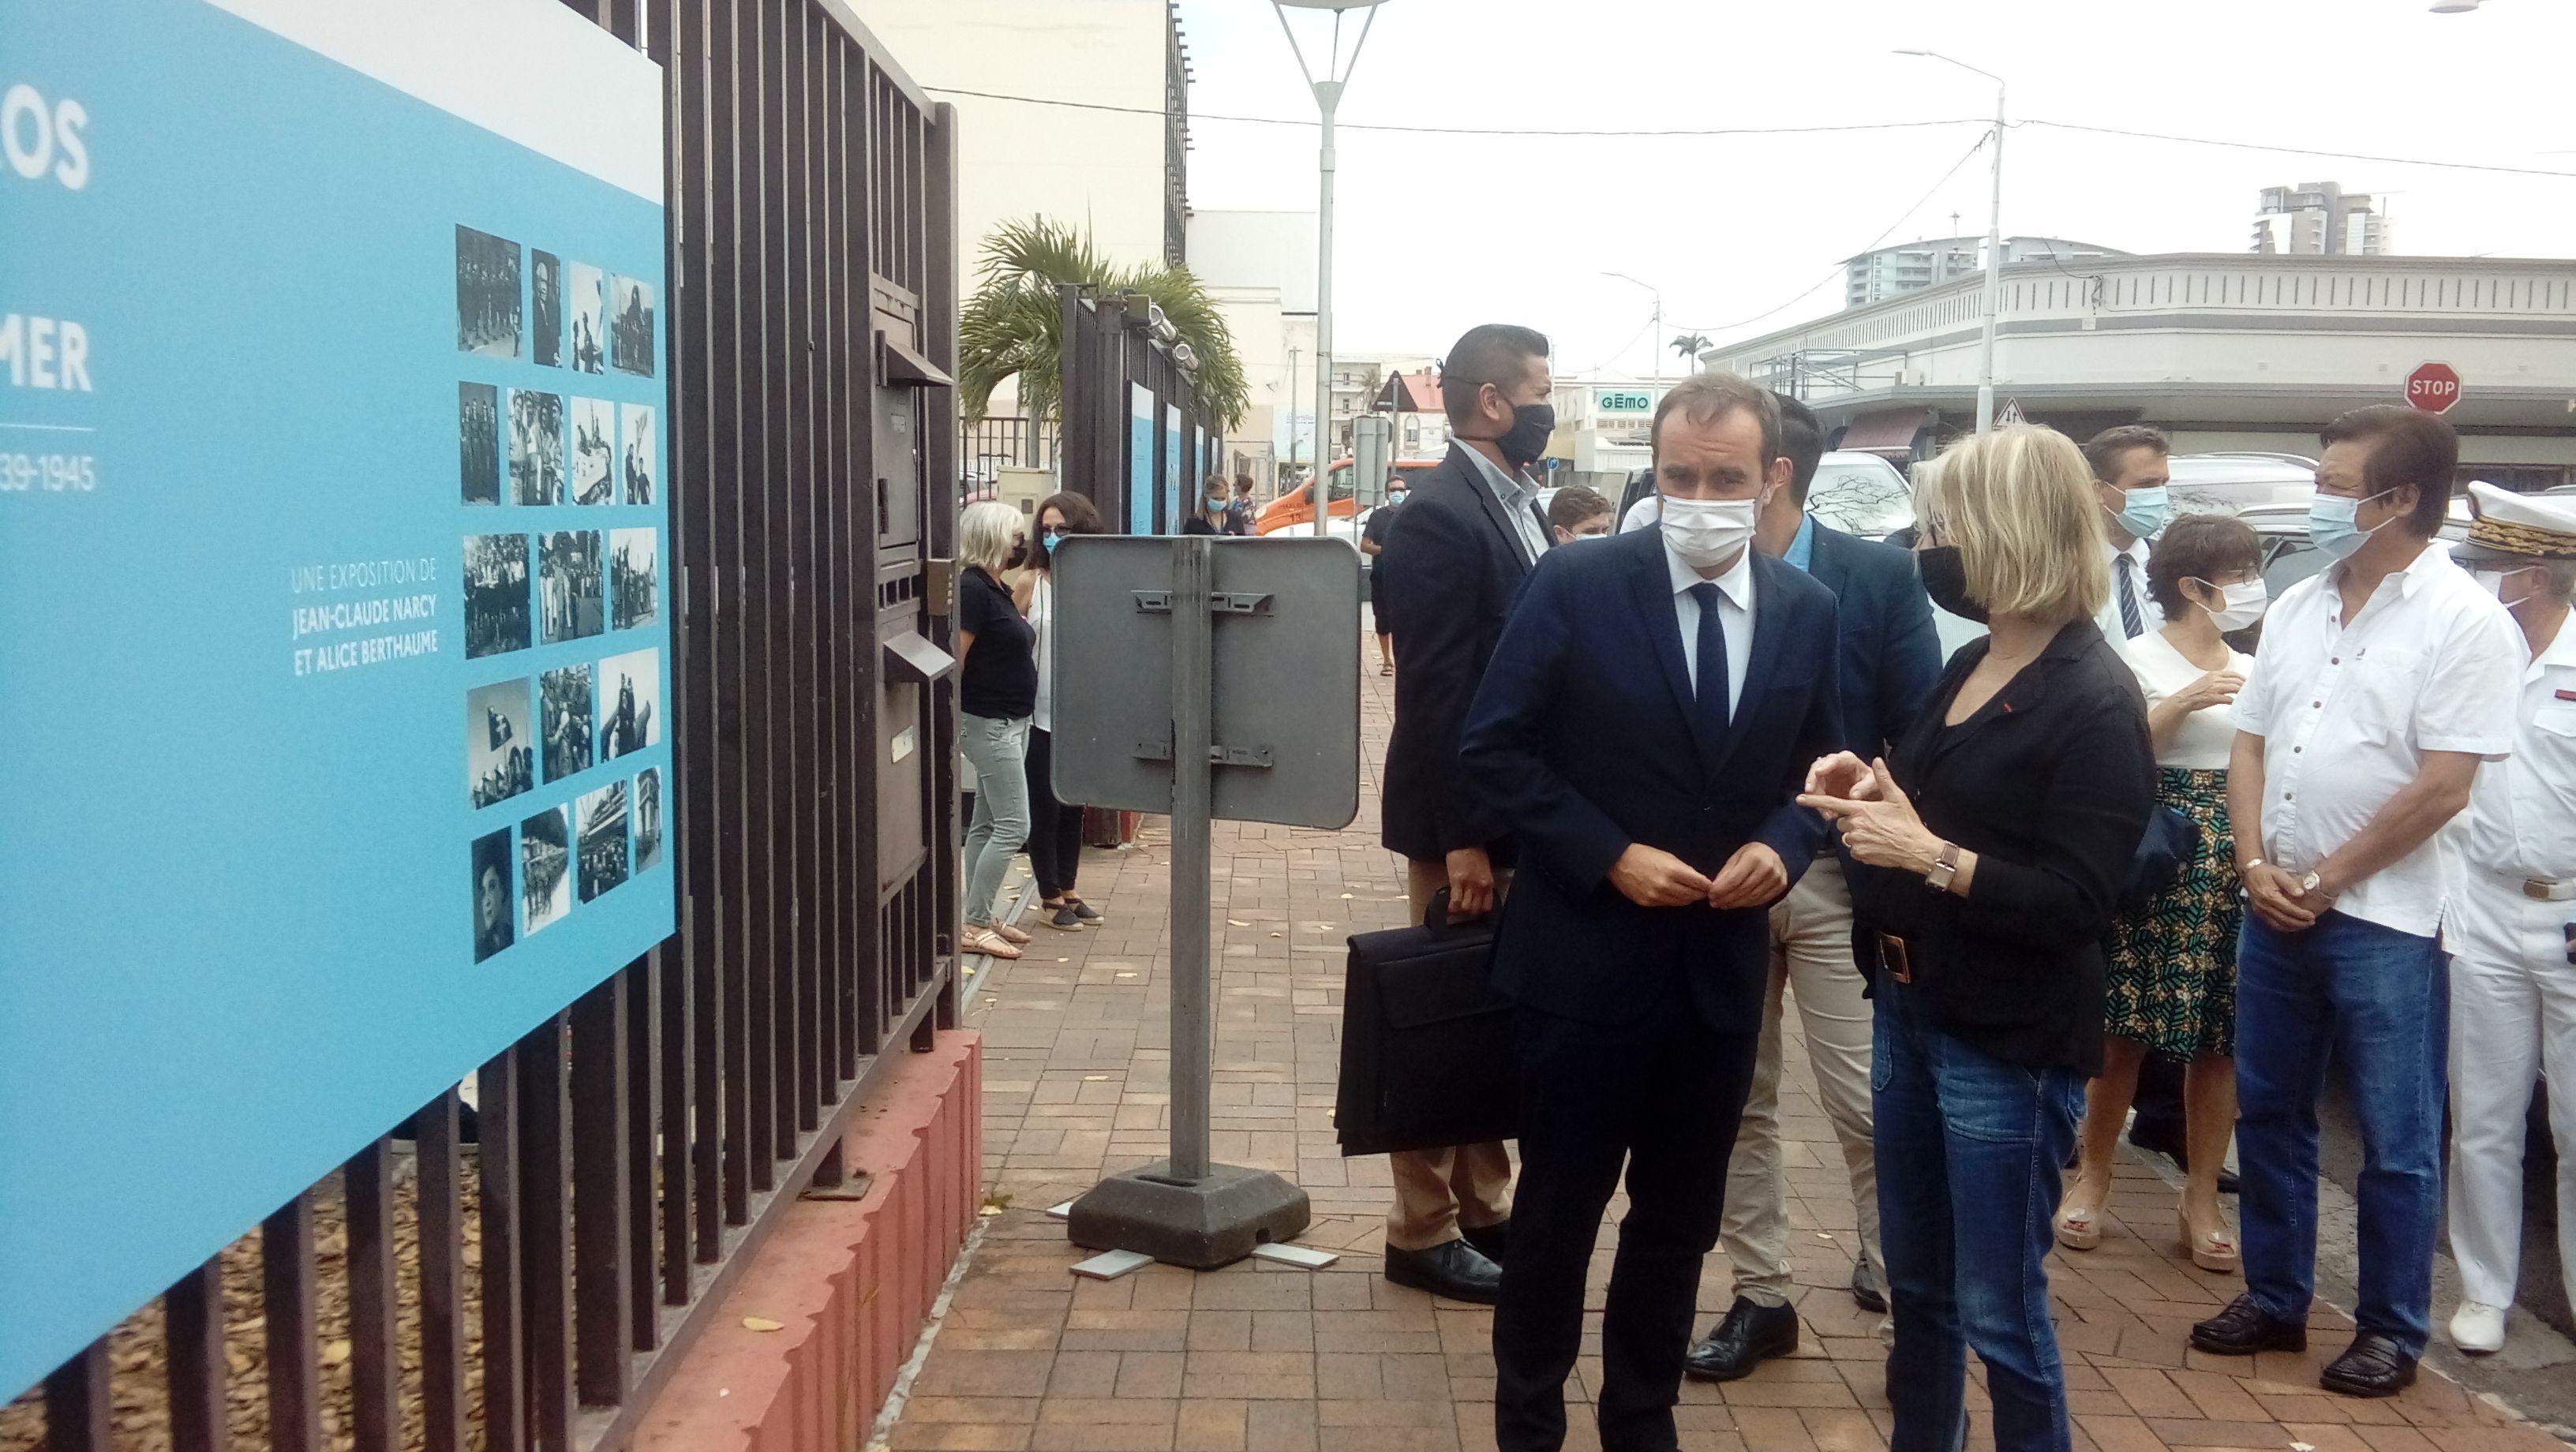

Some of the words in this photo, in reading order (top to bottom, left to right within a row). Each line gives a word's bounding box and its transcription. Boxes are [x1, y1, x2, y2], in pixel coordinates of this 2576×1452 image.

[2412, 380, 2455, 395] STOP
[291, 566, 324, 593] UNE
[330, 559, 415, 590] EXPOSITION
[420, 557, 436, 581] DE
[292, 600, 390, 641] JEAN-CLAUDE
[393, 593, 436, 621] NARCY
[294, 649, 313, 676] ET
[316, 641, 358, 672] ALICE
[361, 630, 439, 664] BERTHAUME
